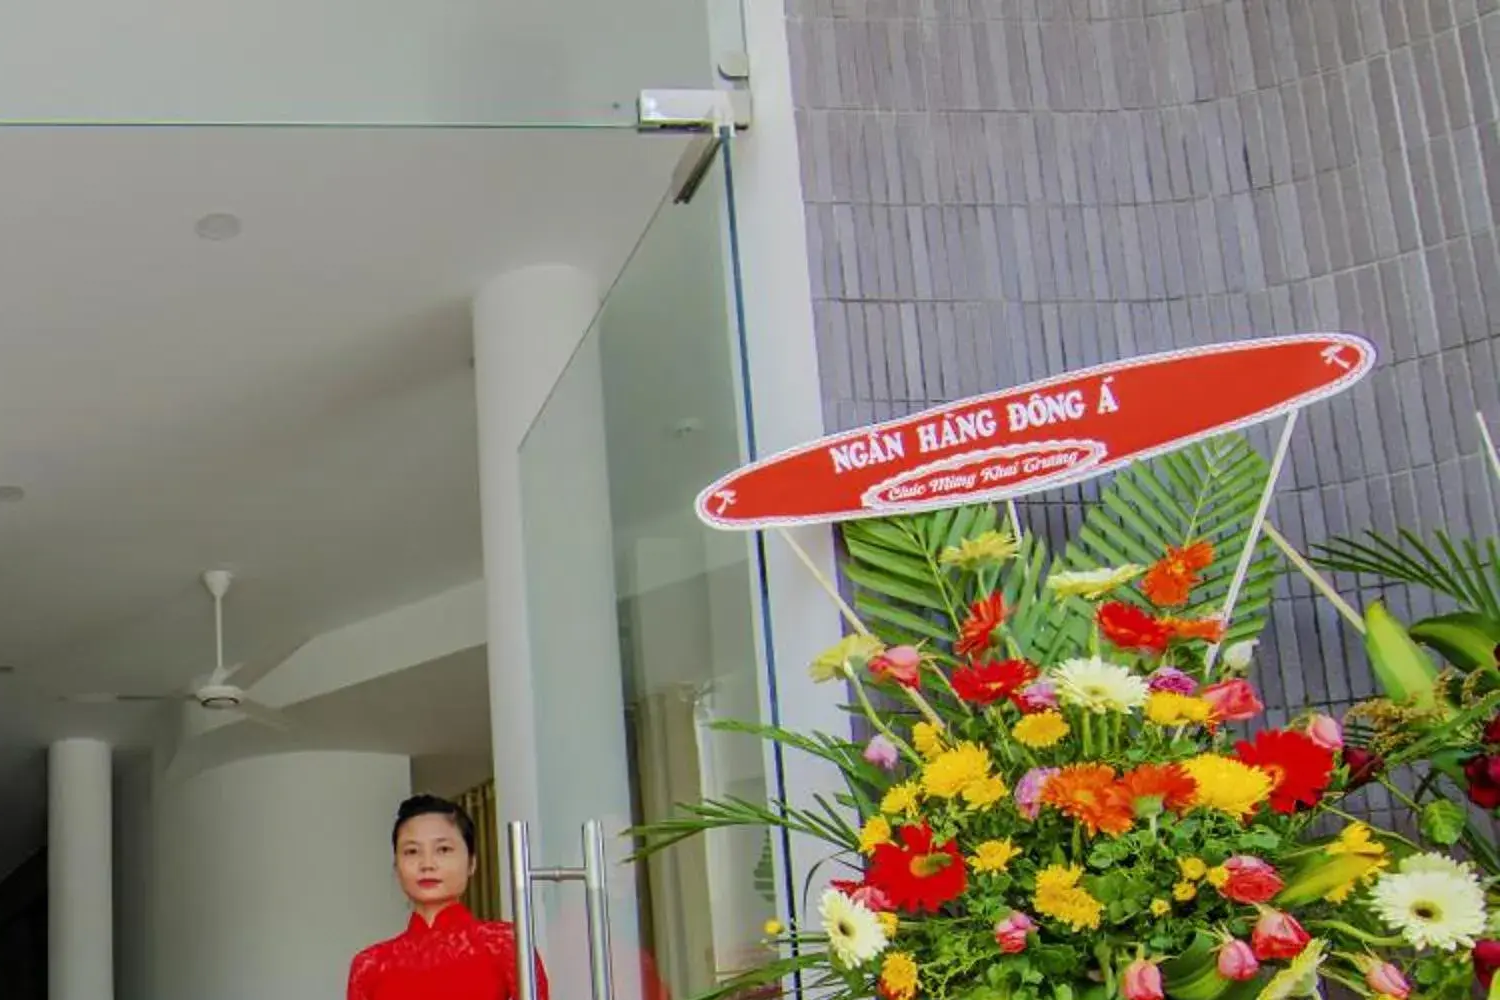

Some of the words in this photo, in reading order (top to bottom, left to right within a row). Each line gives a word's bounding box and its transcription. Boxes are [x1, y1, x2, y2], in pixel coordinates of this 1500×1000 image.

[830, 434, 904, 474] NGÂN
[916, 411, 997, 453] HÀNG
[1007, 391, 1085, 432] ĐÔNG
[1097, 377, 1119, 413] Á
[980, 461, 1018, 482] Khai
